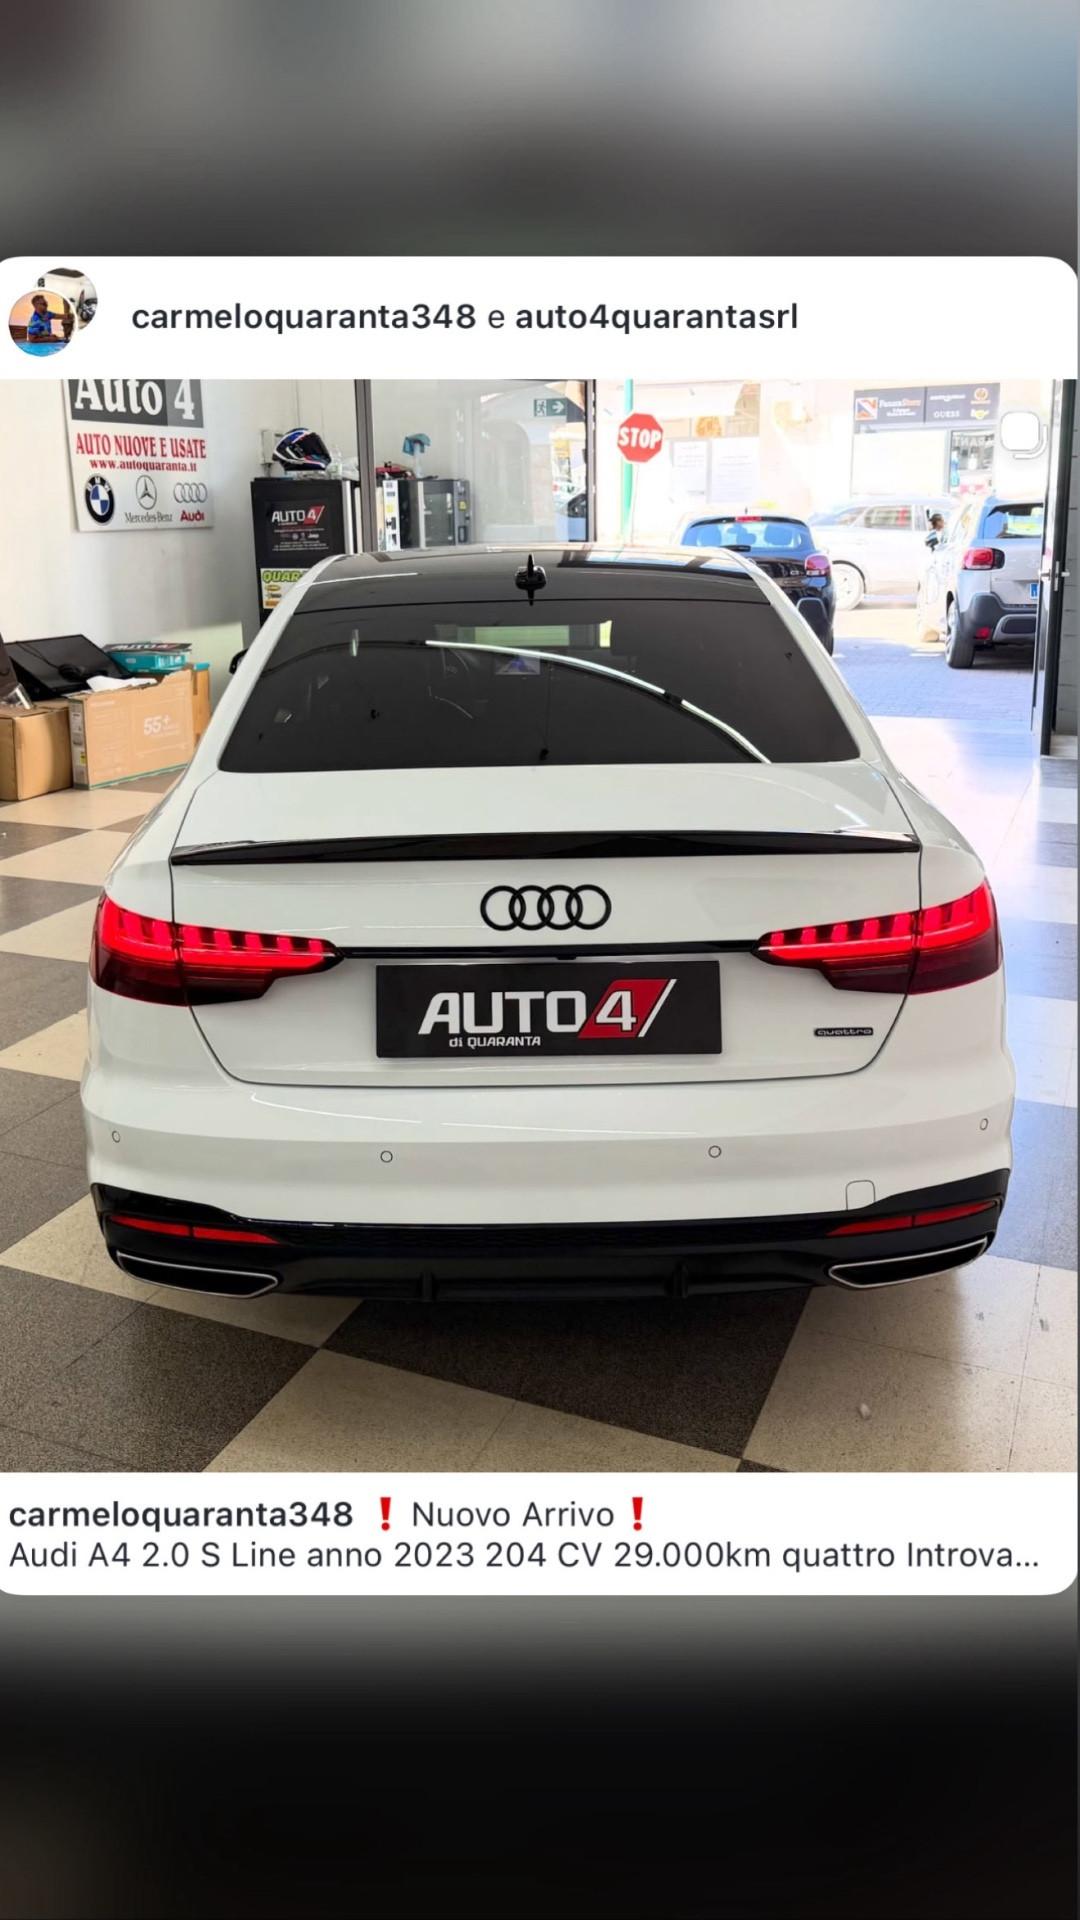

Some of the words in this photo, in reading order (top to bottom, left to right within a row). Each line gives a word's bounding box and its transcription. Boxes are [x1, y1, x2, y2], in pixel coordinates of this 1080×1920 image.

[75, 379, 163, 416] Auto
[174, 379, 196, 420] 4
[618, 427, 662, 449] STOP
[76, 433, 112, 455] AUTO
[113, 435, 157, 458] NUOVE
[160, 437, 167, 458] E
[170, 438, 207, 459] USATE
[89, 459, 198, 473] www.autoquaranta.it
[124, 511, 173, 523] Mercedes-Benz
[180, 510, 205, 522] Audi
[262, 570, 303, 583] QUAR
[816, 1028, 873, 1037] quattro
[448, 1036, 463, 1048] di
[467, 1036, 541, 1050] QUARANTA
